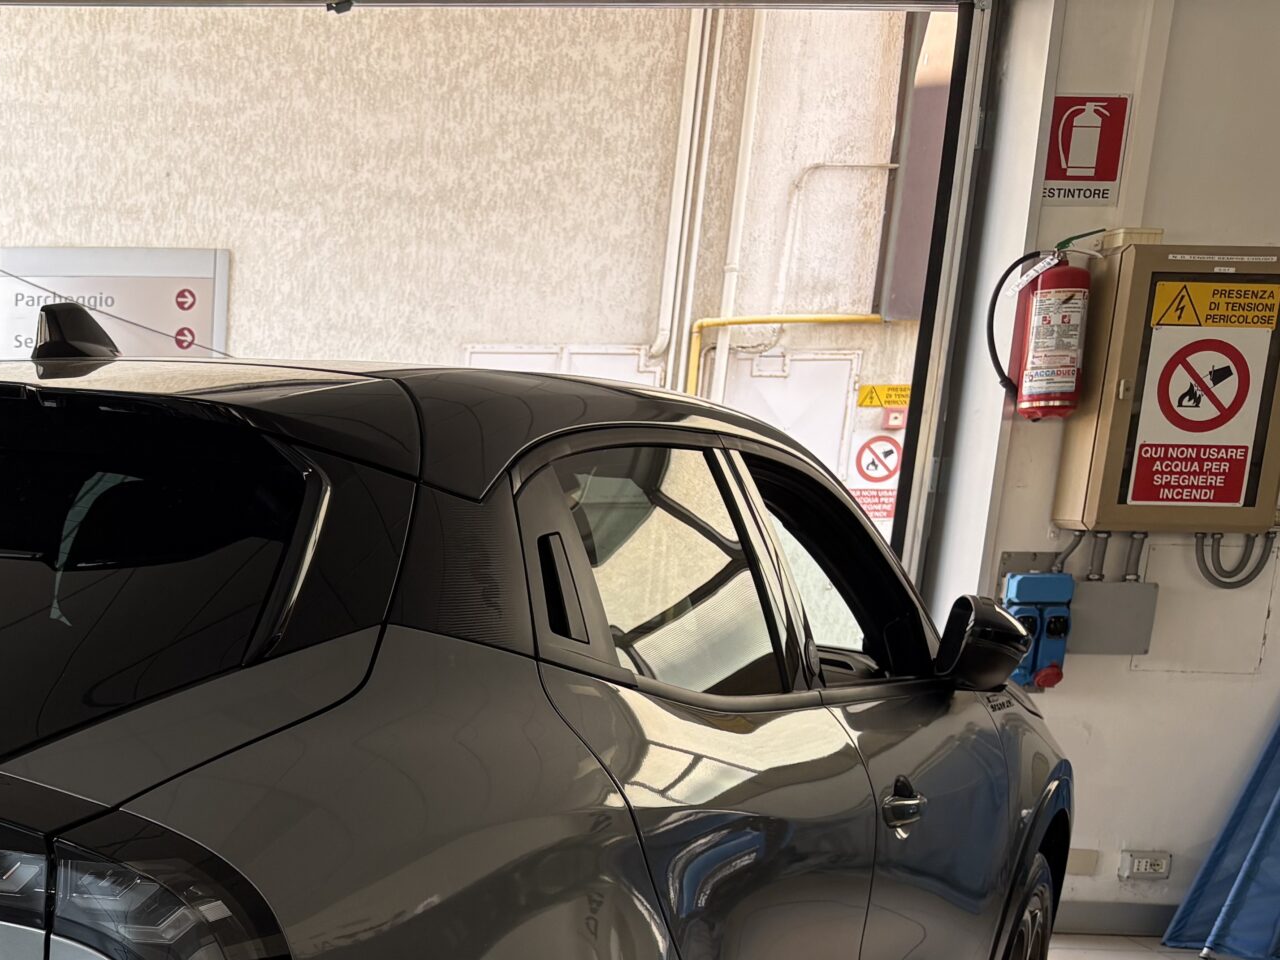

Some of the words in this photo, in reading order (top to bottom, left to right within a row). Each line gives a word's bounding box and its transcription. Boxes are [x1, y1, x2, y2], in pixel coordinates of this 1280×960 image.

[1042, 187, 1110, 199] ESTINTORE
[1212, 288, 1275, 300] PRESENZA
[1209, 301, 1220, 311] DI
[1225, 301, 1275, 312] TENSIONI
[1205, 313, 1275, 325] PERICOLOSE
[1141, 447, 1165, 458] QUI
[1167, 447, 1197, 458] NON
[1200, 448, 1246, 459] USARE
[1152, 461, 1200, 473] ACQUA
[1203, 461, 1230, 473] PER
[1153, 474, 1225, 486] SPEGNERE
[1159, 488, 1215, 500] INCENDI
